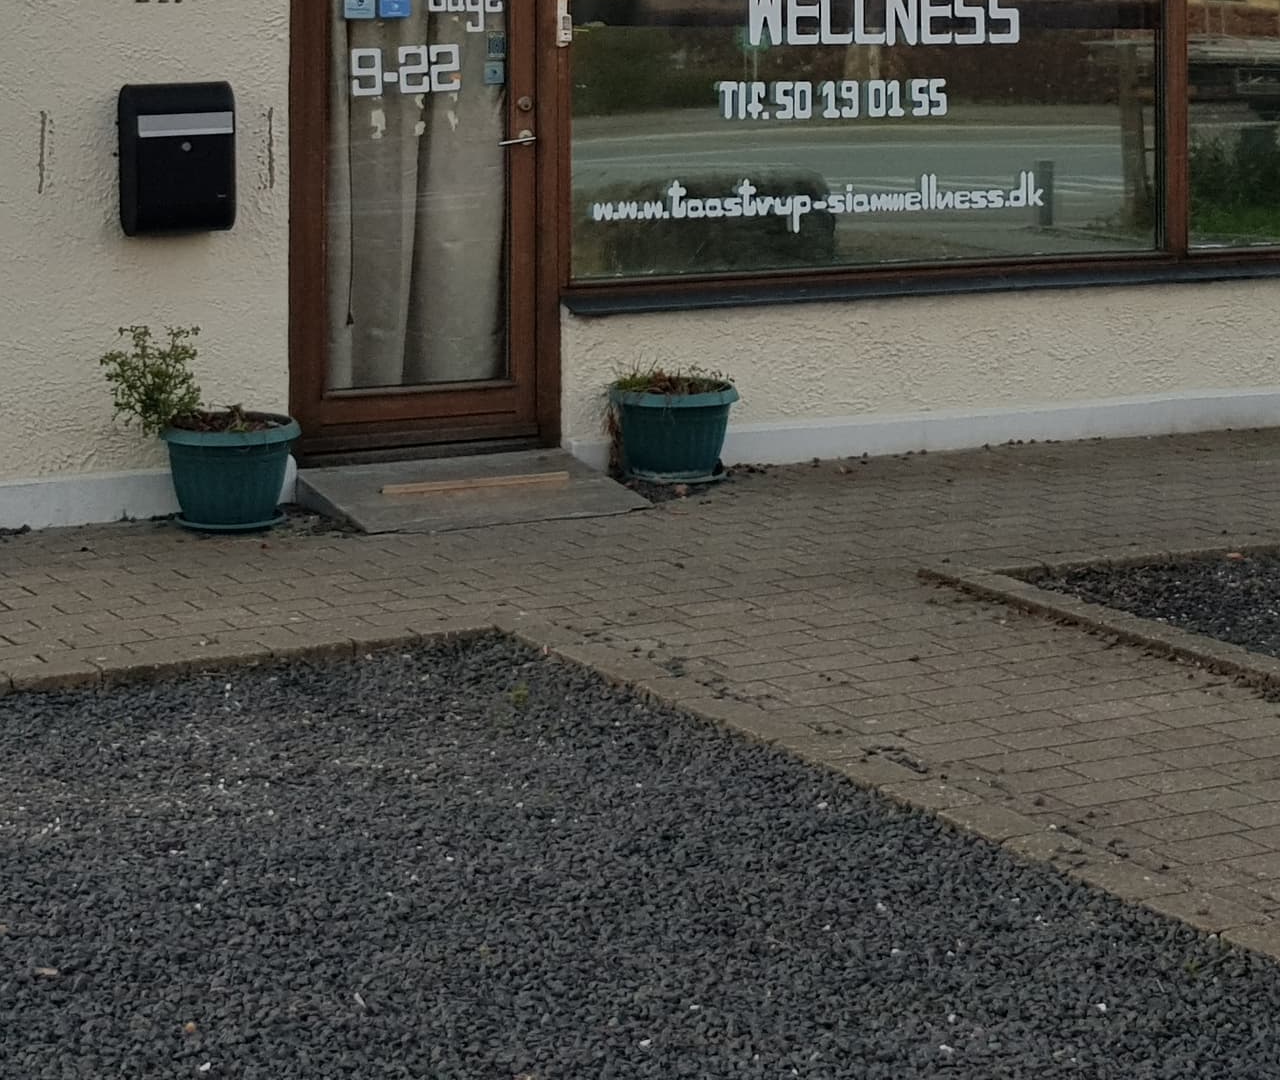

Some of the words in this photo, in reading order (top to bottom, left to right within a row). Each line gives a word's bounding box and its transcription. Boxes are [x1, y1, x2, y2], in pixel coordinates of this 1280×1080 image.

[351, 44, 461, 96] 9-22
[775, 81, 812, 119] 50
[823, 80, 859, 118] 19
[869, 79, 905, 117] 01
[911, 78, 948, 116] 55
